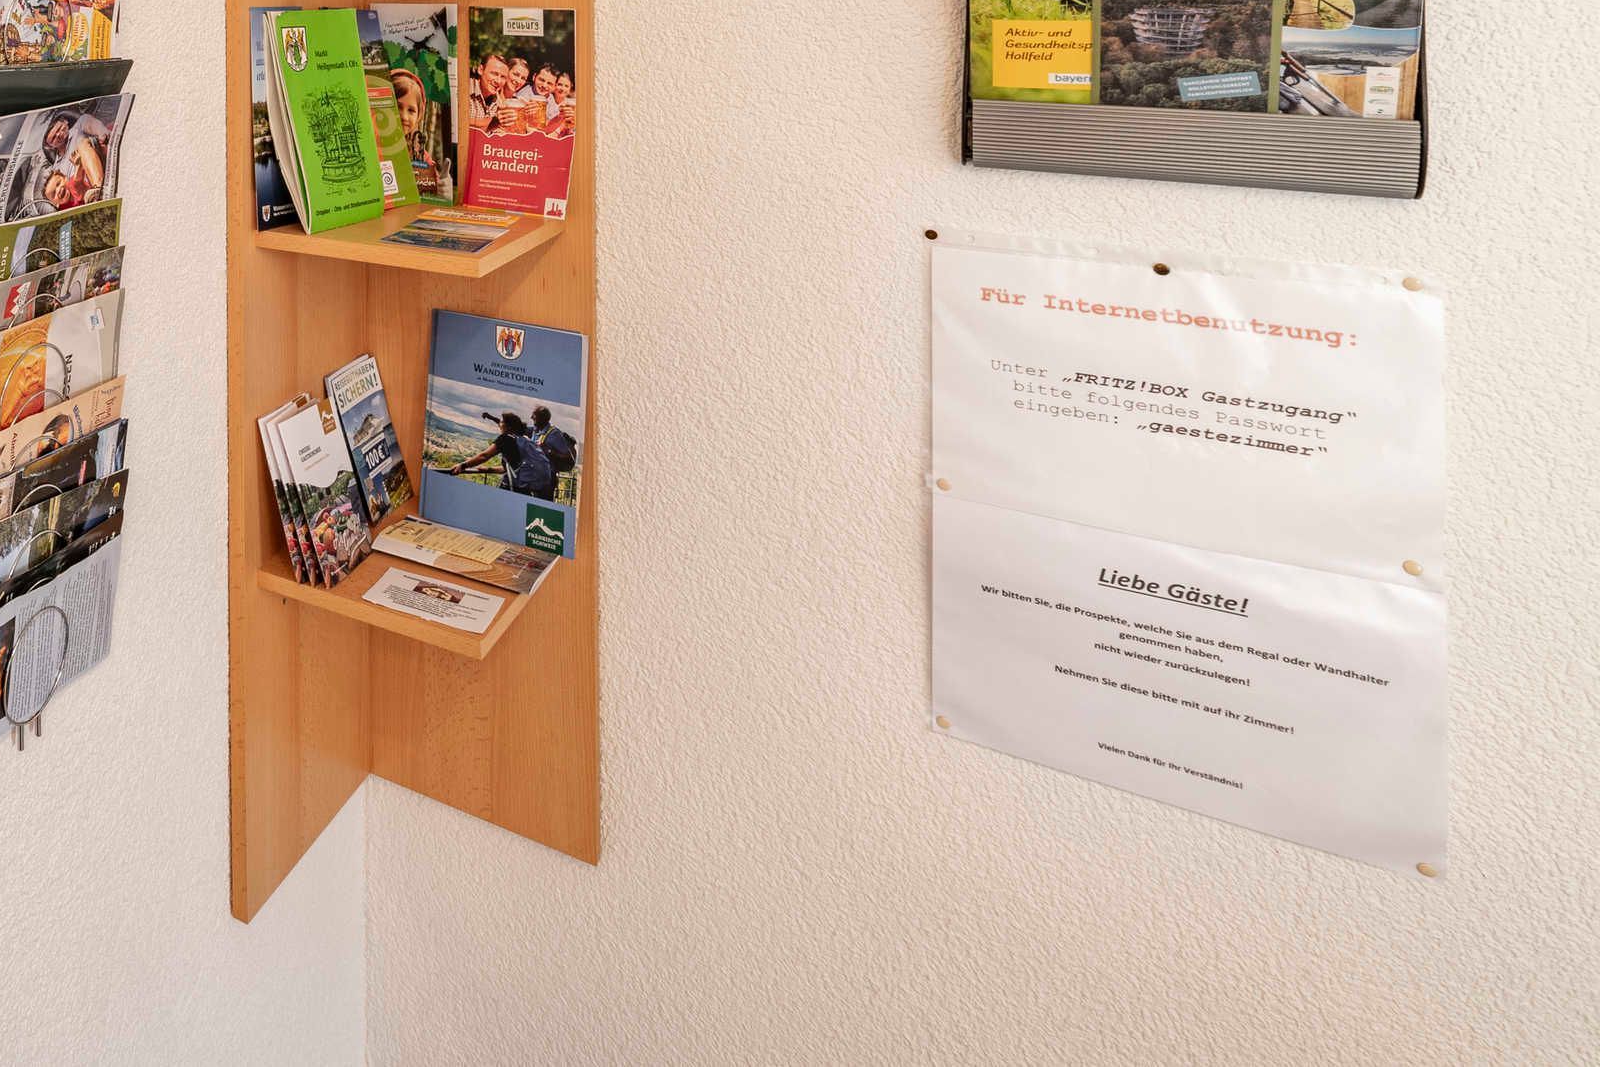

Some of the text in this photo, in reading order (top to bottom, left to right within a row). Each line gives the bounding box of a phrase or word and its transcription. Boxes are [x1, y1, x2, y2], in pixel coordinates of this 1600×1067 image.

[1004, 28, 1072, 38] Aktiv- und
[1004, 51, 1054, 62] Hollfeld
[483, 143, 542, 160] Brauerei-
[481, 160, 538, 175] wandern
[980, 287, 1359, 348] Für Internetbenutzung:
[474, 363, 544, 386] WANDERTOUREN
[990, 360, 1049, 378] Unter
[339, 374, 379, 409] SICHERN!
[1014, 379, 1326, 439] bitte folgendes Passwort
[1014, 399, 1120, 426] eingeben:
[366, 445, 385, 469] 100€
[1098, 568, 1249, 615] Liebe Gäste!
[981, 584, 1390, 686] Wir bitten Sie, die Prospekte, welche Sie aus dem Regal oder Wandhalter
[1119, 631, 1224, 663] genommen haben,
[1094, 642, 1251, 687] nicht wieder zurückzulegen!
[1054, 665, 1295, 735] Nehmen Sie diese bitte mit auf ihr Zimmer!
